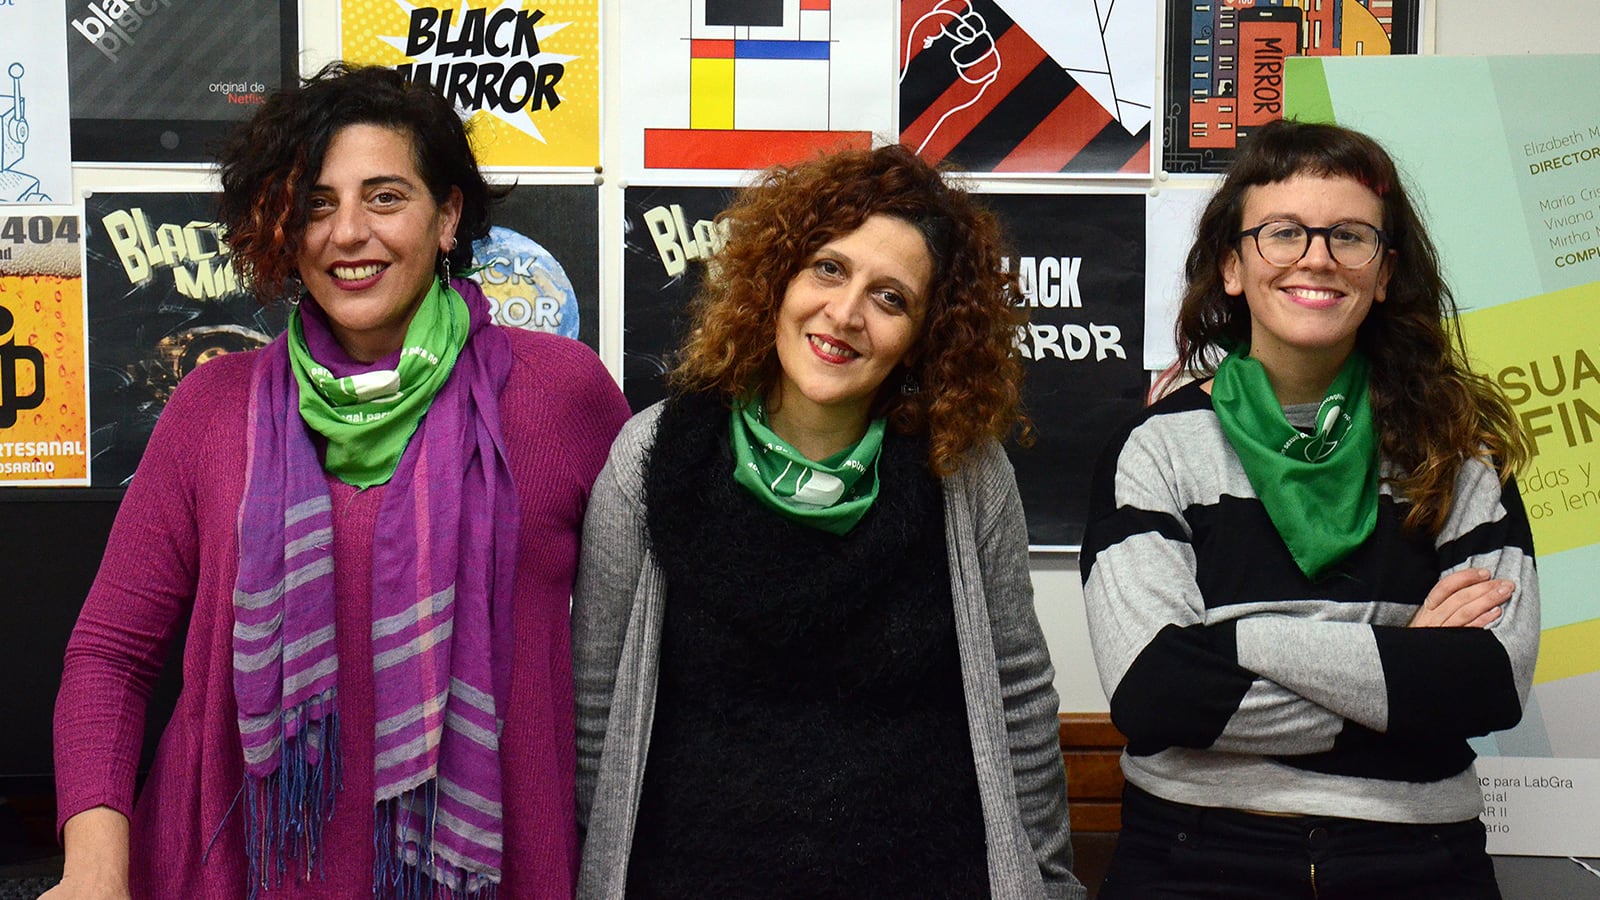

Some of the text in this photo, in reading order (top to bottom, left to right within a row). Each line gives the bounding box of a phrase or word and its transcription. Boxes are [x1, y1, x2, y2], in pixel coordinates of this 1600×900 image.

[71, 0, 135, 44] bla
[405, 7, 546, 58] BLACK
[208, 81, 265, 95] original de
[1253, 37, 1282, 115] MIRROR
[1524, 126, 1600, 157] Elizabeth M
[1, 215, 81, 244] 404
[1543, 210, 1593, 230] Viviana
[1549, 230, 1591, 249] Mirtha
[1578, 462, 1591, 488] y
[1561, 486, 1600, 512] len
[1494, 777, 1521, 789] para
[1524, 775, 1574, 789] LabGra
[1483, 791, 1508, 803] cial
